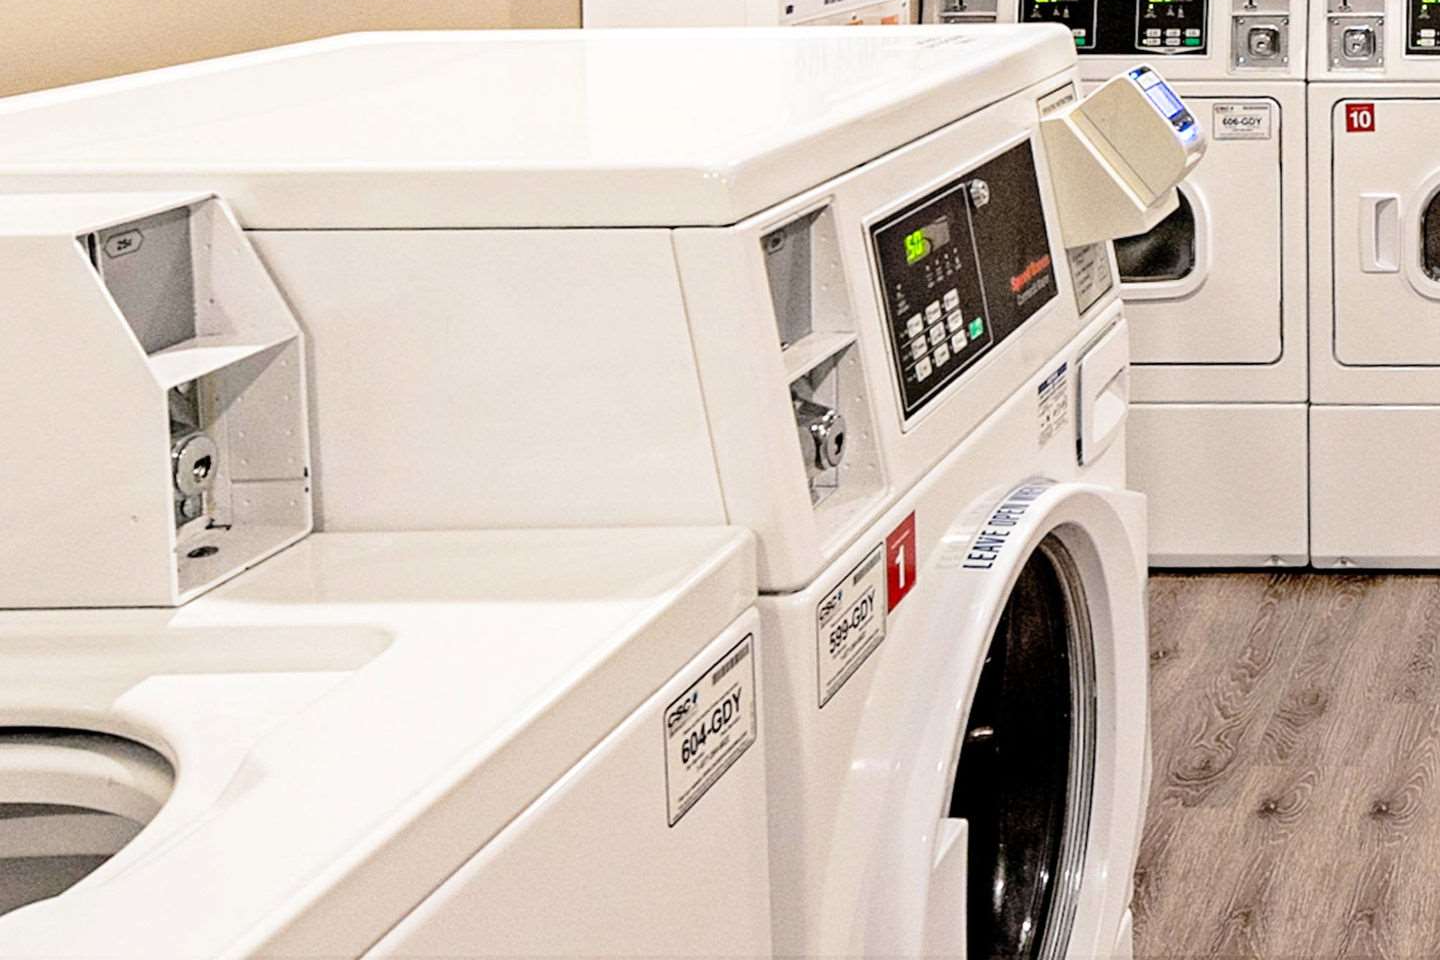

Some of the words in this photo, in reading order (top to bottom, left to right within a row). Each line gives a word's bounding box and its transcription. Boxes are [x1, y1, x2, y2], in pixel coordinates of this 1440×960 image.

[1349, 110, 1371, 129] 10
[895, 543, 906, 589] 1
[963, 530, 1010, 568] LEAVE
[988, 504, 1030, 527] OPEN
[829, 589, 876, 654] 599-GDY
[681, 686, 743, 764] 604-GDY
